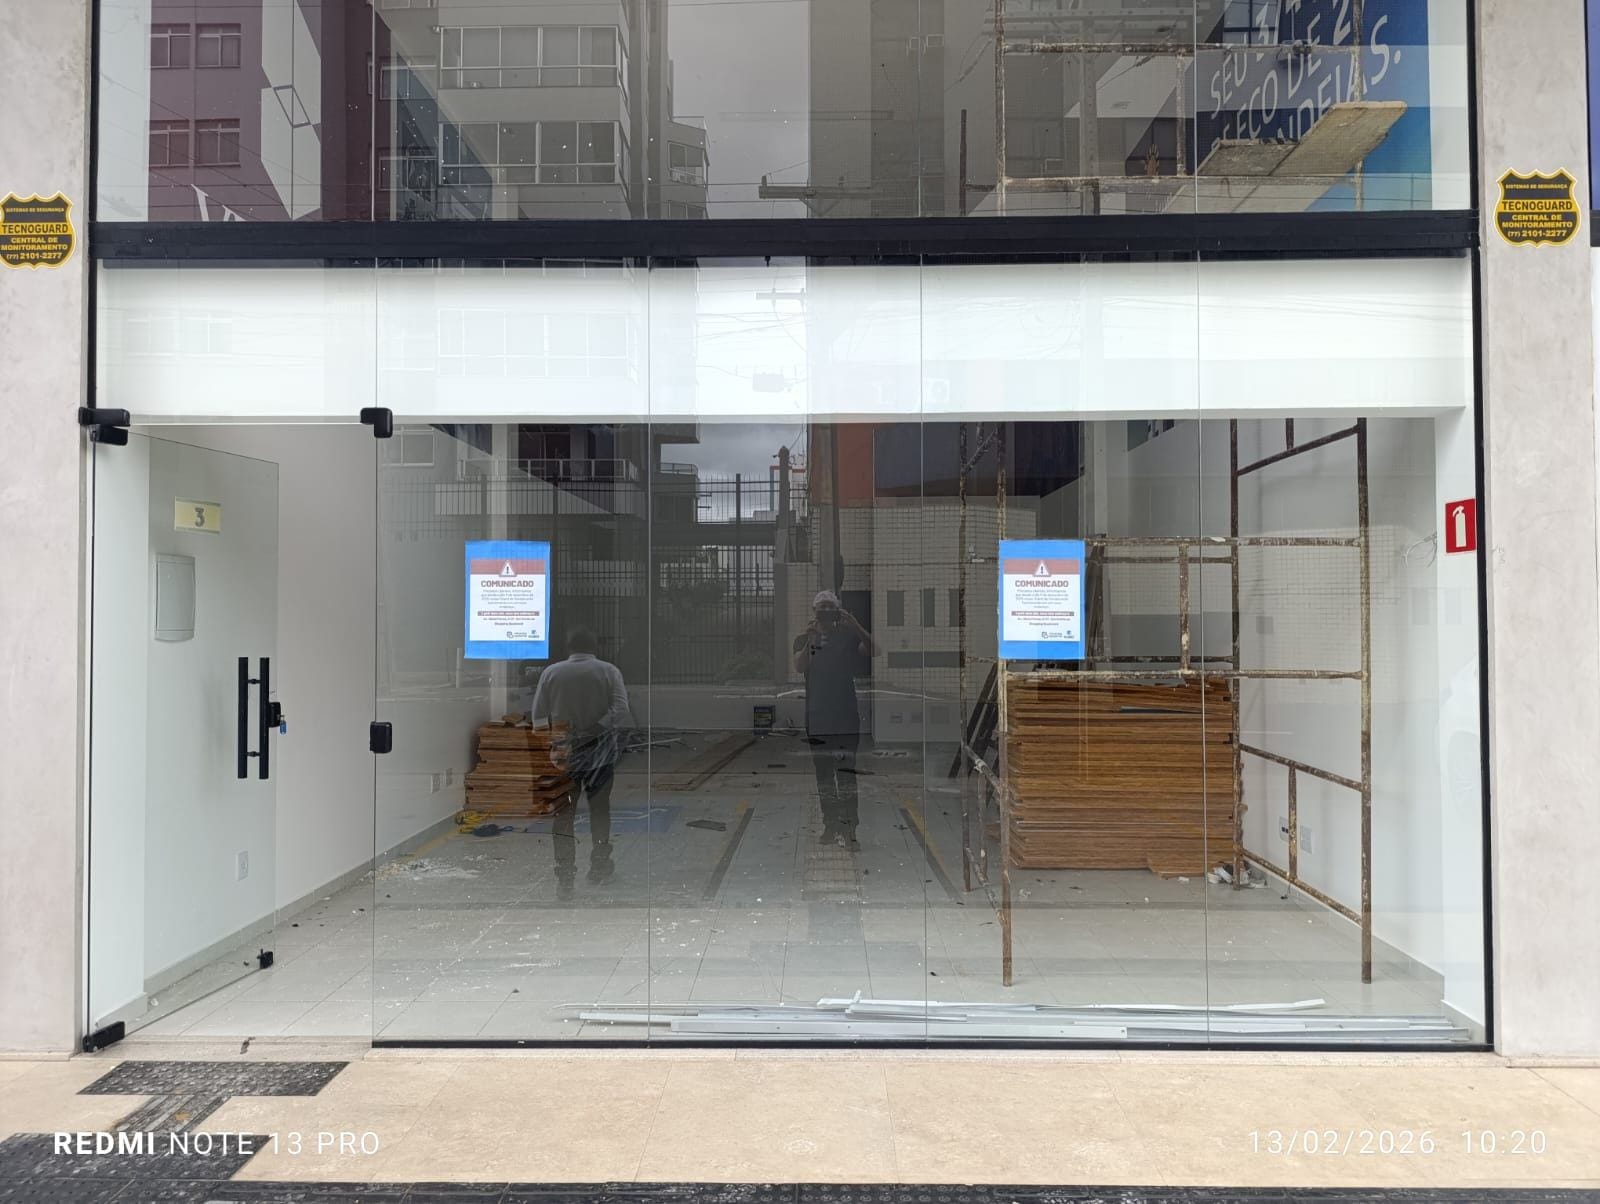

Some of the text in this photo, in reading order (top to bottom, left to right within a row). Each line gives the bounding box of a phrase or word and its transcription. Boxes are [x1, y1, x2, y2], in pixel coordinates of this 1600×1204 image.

[1288, 13, 1321, 100] DE
[1211, 32, 1247, 119] SEU
[1502, 201, 1573, 211] TECNOGUARD
[1, 224, 69, 234] TECNOGUARD
[1522, 229, 1567, 237] 2101-2277
[20, 252, 63, 260] 2101-2277
[194, 507, 206, 528] 3
[480, 580, 535, 588] COMUNICADO
[1015, 580, 1069, 588] COMUNICADO
